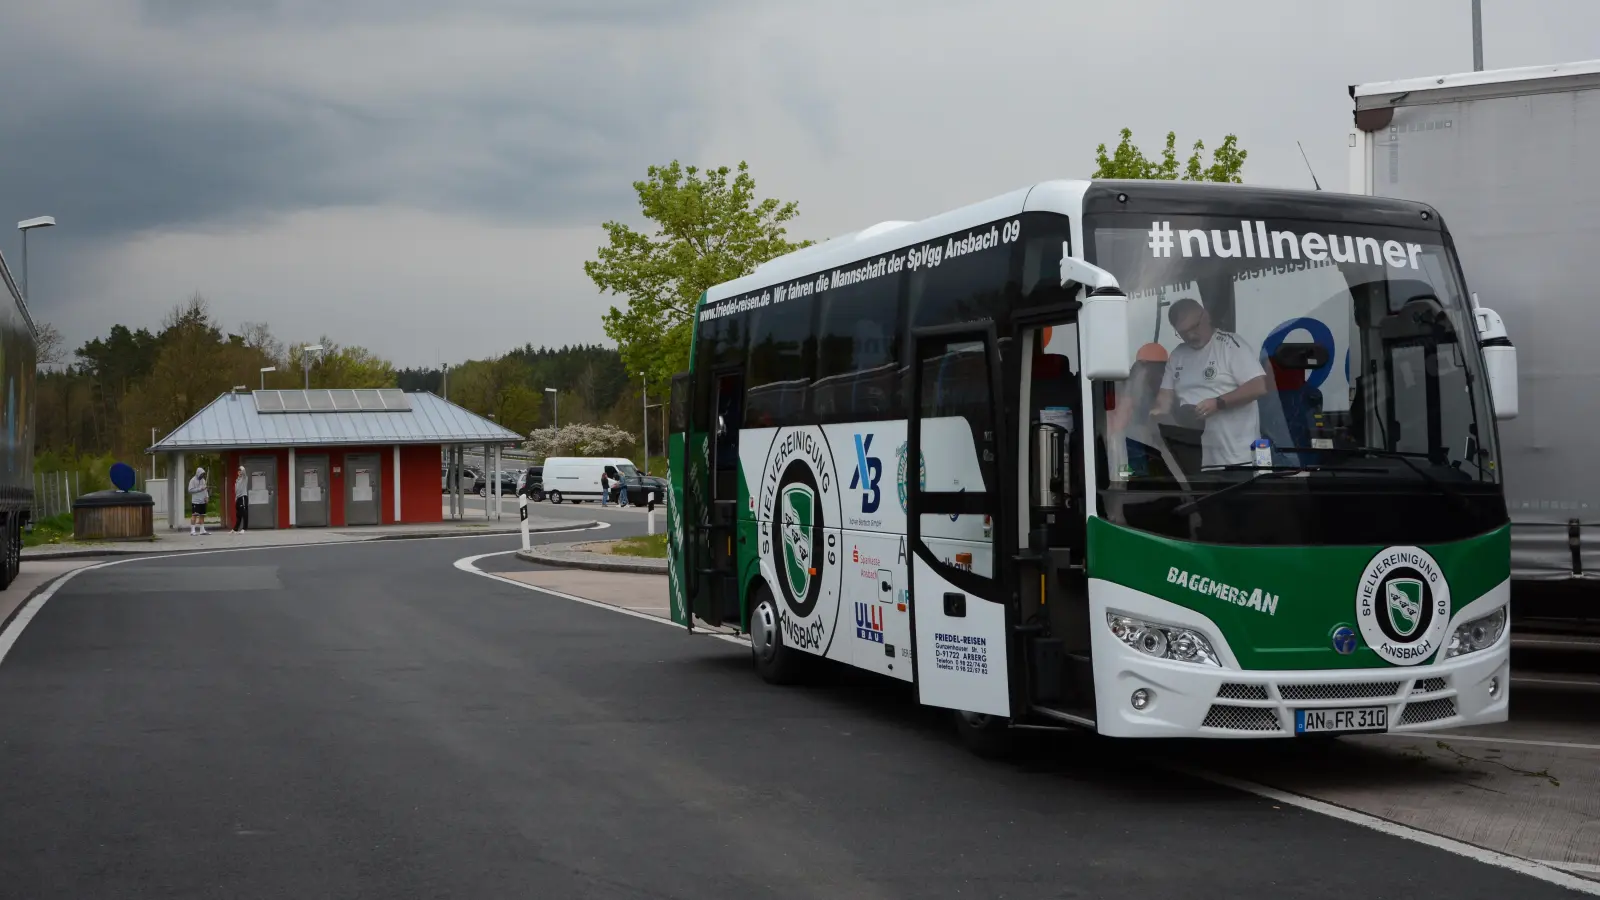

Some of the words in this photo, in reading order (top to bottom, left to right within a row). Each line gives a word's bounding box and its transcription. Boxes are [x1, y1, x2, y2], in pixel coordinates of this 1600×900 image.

[1148, 220, 1422, 270] #nullneuner
[700, 290, 770, 322] www.friedel-reisen.de
[773, 286, 787, 304] Wir
[788, 280, 814, 299] fahren
[816, 274, 829, 292] die
[831, 257, 886, 290] Mannschaft
[888, 254, 905, 274] der
[907, 244, 942, 271] SpVgg
[944, 226, 999, 260] Ansbach
[1002, 220, 1020, 244] 09
[763, 430, 831, 554] SPIELVEREINIGUNG
[828, 534, 836, 566] 09
[1363, 552, 1438, 616] SPIELVEREINIGUNG
[1438, 600, 1446, 615] 09
[780, 608, 825, 649] ANSBACH
[855, 602, 883, 631] ULLI
[861, 632, 880, 642] BAU
[935, 633, 986, 646] FRIEDEL-REISEN
[1380, 639, 1431, 659] ANSBACH
[936, 650, 959, 659] D-91722
[963, 653, 987, 662] ARBERG
[1306, 712, 1325, 729] AN
[1335, 711, 1354, 728] FR
[1358, 710, 1385, 727] 310
